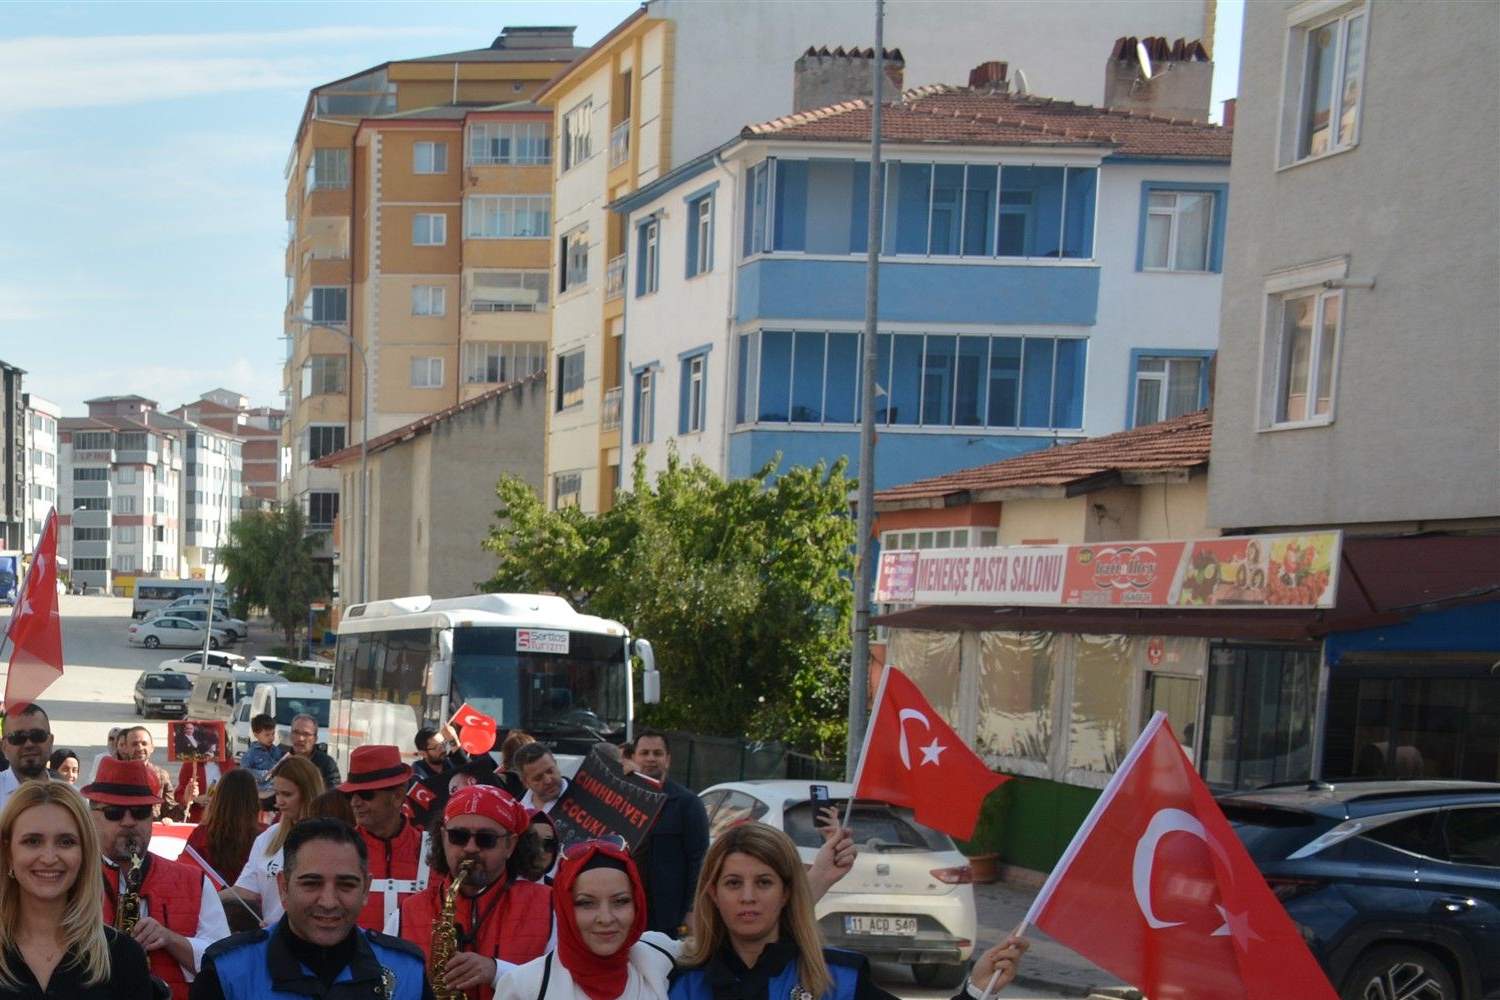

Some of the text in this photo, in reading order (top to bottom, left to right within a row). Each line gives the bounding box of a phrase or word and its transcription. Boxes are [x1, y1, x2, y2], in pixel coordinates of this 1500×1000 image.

[971, 556, 1008, 592] PASTA
[1010, 554, 1063, 592] SALONU
[852, 918, 862, 930] 11
[895, 919, 916, 932] 540
